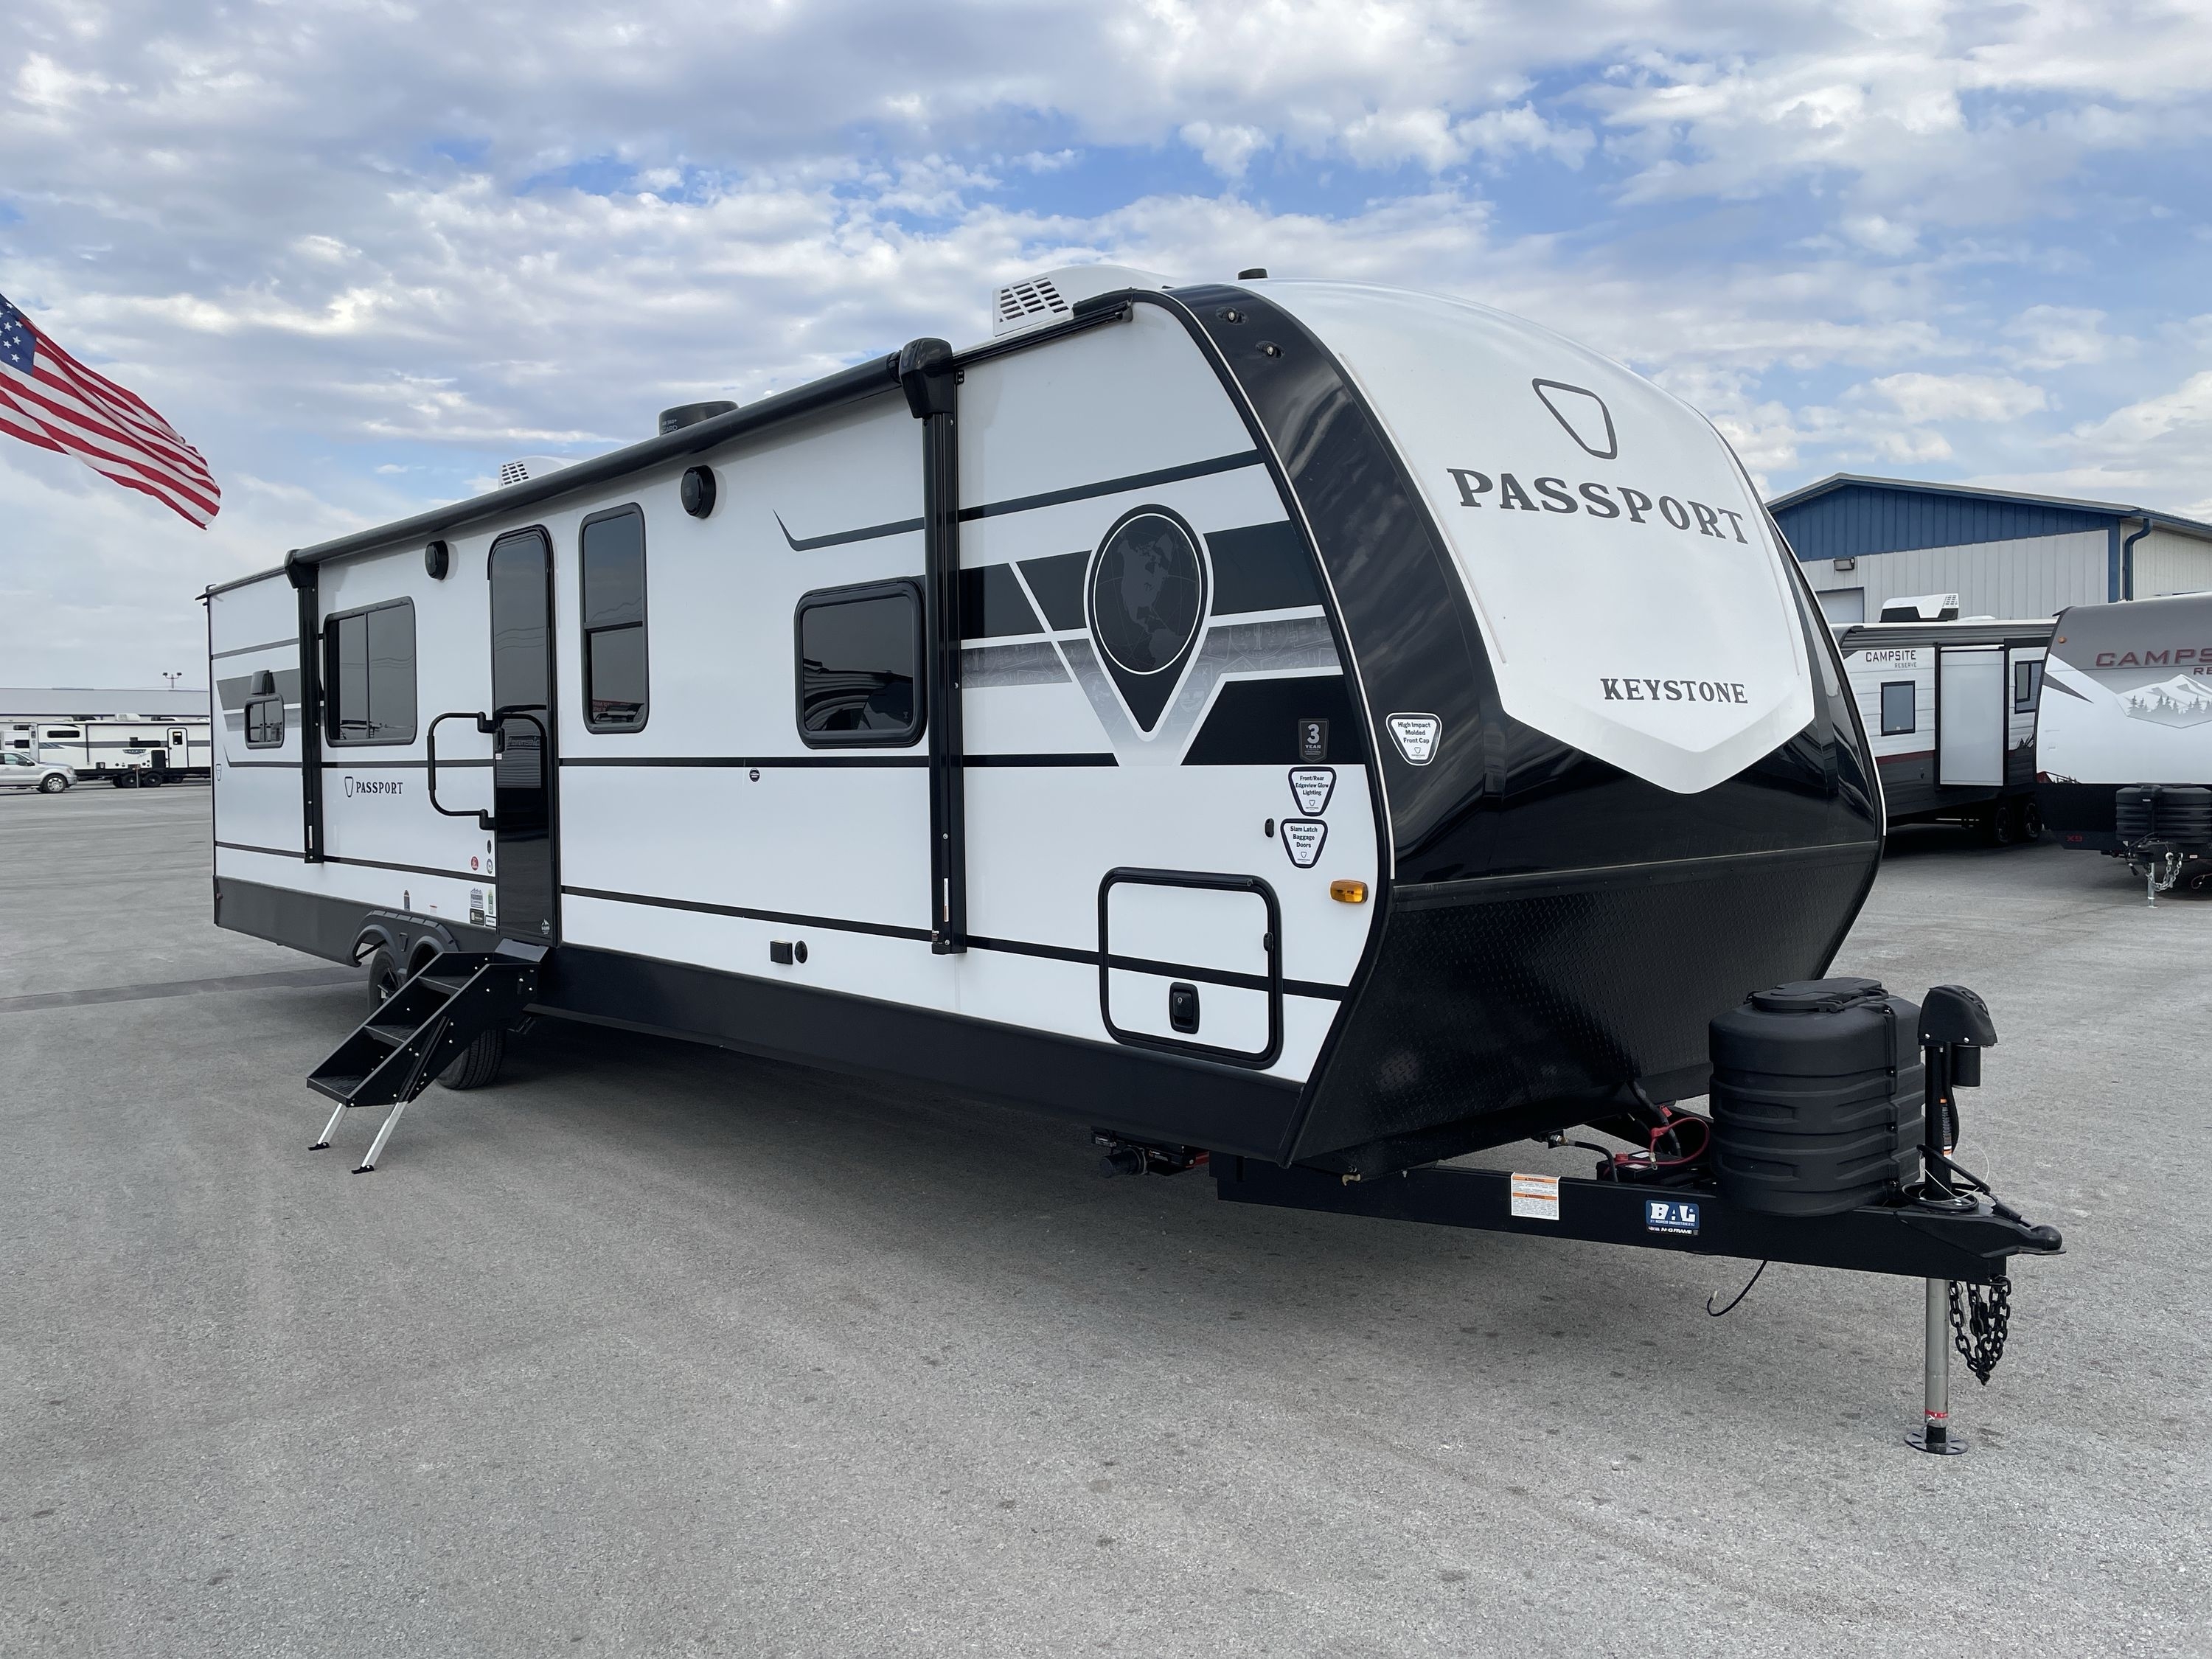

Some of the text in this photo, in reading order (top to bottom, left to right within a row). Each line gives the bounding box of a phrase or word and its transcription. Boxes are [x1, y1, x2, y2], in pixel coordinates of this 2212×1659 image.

[1447, 468, 1748, 544] PASSPORT
[1865, 650, 1916, 662] CAMPSITE
[1600, 678, 1748, 704] KEYSTONE
[1307, 723, 1320, 744] 3
[356, 782, 403, 794] PASSPORT
[1293, 833, 1315, 841] Baggage
[1651, 1203, 1695, 1222] BAL
